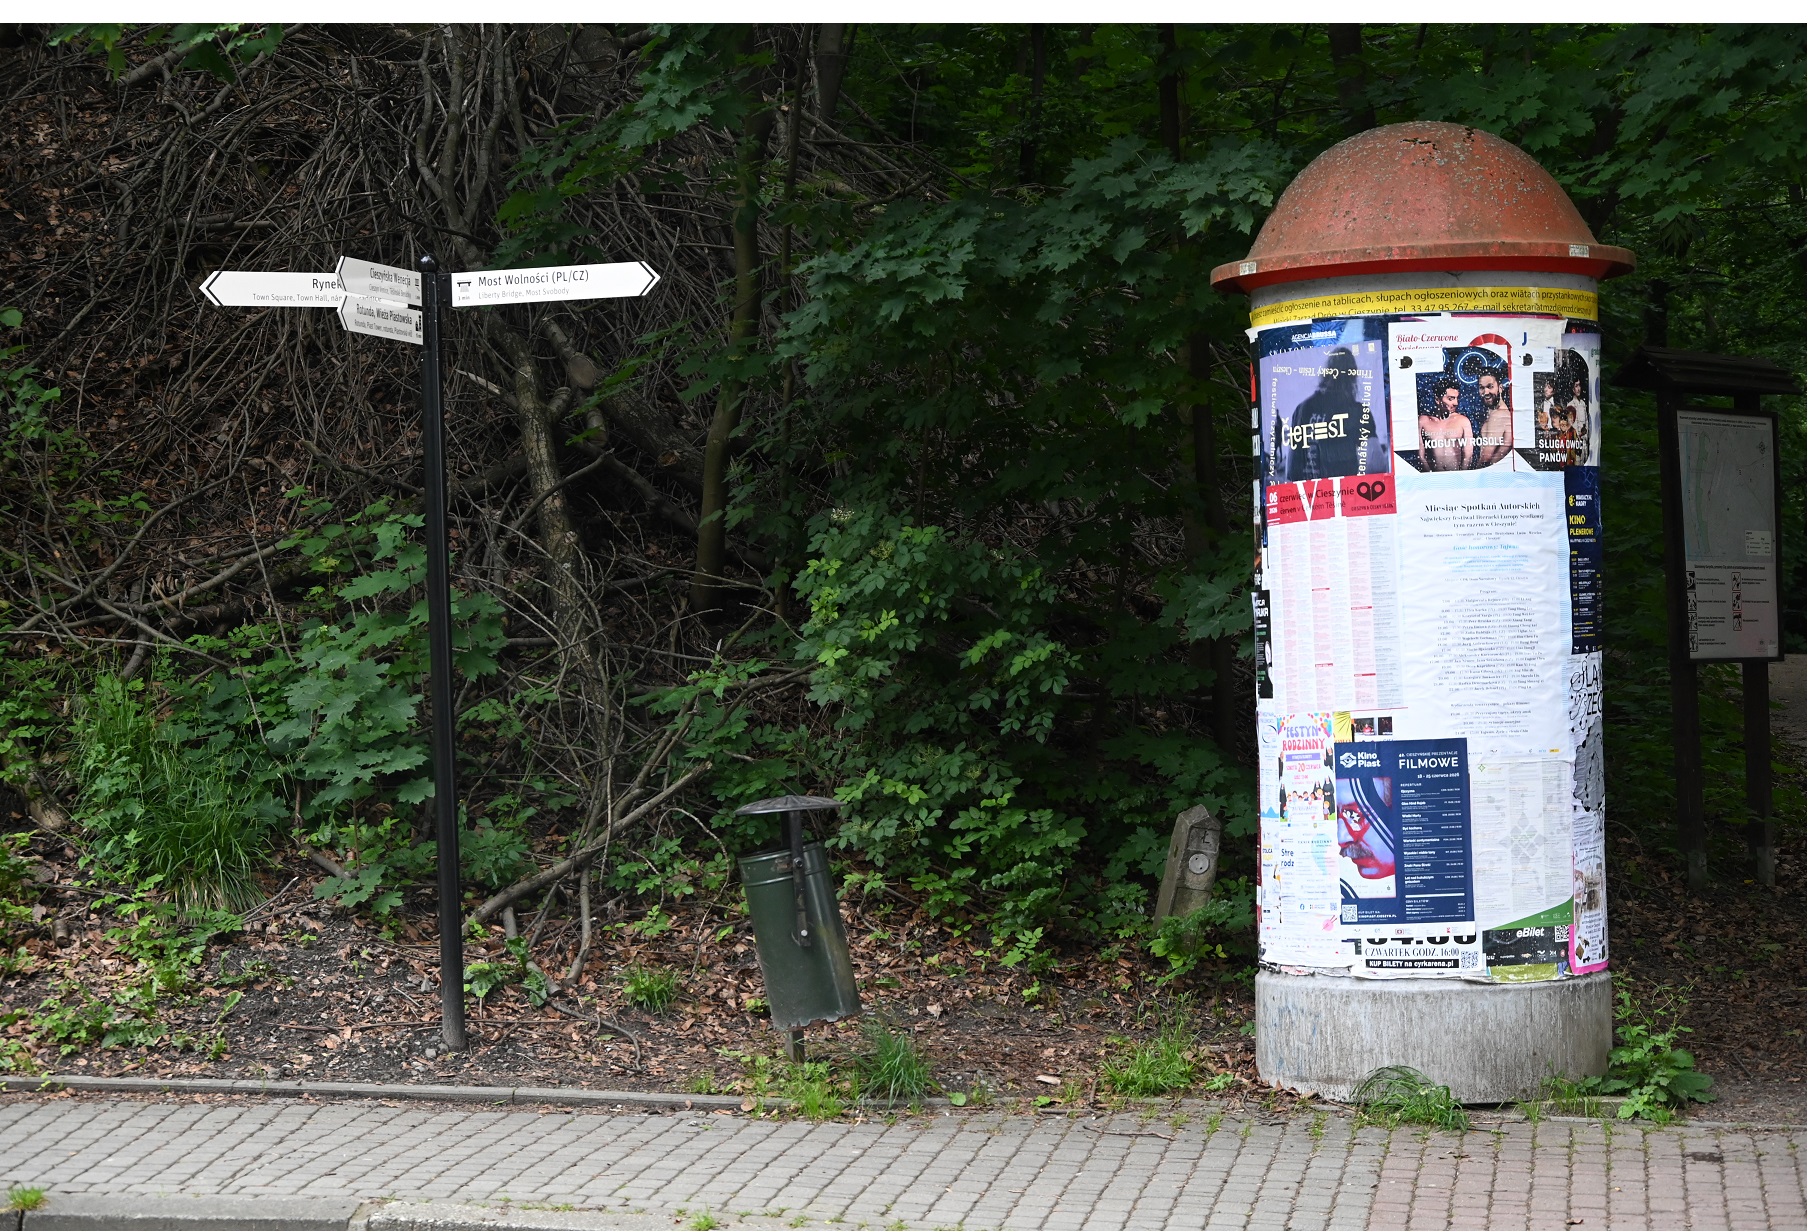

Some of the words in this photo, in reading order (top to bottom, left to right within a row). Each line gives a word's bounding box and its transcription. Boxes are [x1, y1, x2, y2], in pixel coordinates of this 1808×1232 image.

[478, 276, 502, 287] Most
[505, 271, 549, 285] Wolności
[551, 269, 589, 284] (PL/CZ)
[253, 293, 270, 301] Town
[271, 293, 295, 302] Square,
[296, 293, 314, 301] Town
[314, 294, 330, 302] Hall,
[478, 291, 500, 300] Liberty
[501, 289, 524, 299] Bridge,
[525, 288, 541, 296] Most
[542, 287, 570, 296] Svobody
[1284, 299, 1320, 314] ogłoszenie
[1321, 299, 1331, 307] na
[1333, 294, 1374, 306] tablicach,
[1376, 291, 1412, 303] słupach
[1414, 289, 1489, 301] ogłoszeniowych
[1490, 291, 1509, 299] oraz
[1510, 289, 1541, 299] wiatach
[1410, 304, 1423, 312] 33
[1423, 303, 1436, 312] 47
[1438, 303, 1450, 312] 95
[1473, 302, 1501, 311] e-mail
[1359, 381, 1372, 425] festival
[1424, 437, 1457, 450] KOGUT
[1458, 437, 1468, 448] W
[1538, 438, 1565, 449] SŁUGA
[1356, 427, 1371, 476] tenářský
[1269, 491, 1278, 503] 06
[1315, 487, 1355, 499] Cieszynie
[1424, 503, 1459, 513] Miesiąc
[1460, 502, 1497, 513] Spotkań
[1498, 502, 1541, 511] Autorskich
[1569, 514, 1586, 525] KINO
[1286, 725, 1319, 738] FESTYN
[1282, 738, 1326, 751] RODZINNY
[1357, 751, 1378, 760] Kino
[1357, 759, 1381, 768] Piast
[1398, 756, 1459, 769] FILMOWE
[1516, 926, 1545, 938] eBilet
[1365, 947, 1411, 957] CZWARTEK
[1412, 947, 1439, 957] GODZ.
[1440, 947, 1460, 957] 16:00
[1382, 959, 1404, 967] BILETY
[1413, 959, 1454, 968] cyrkarena.pl
